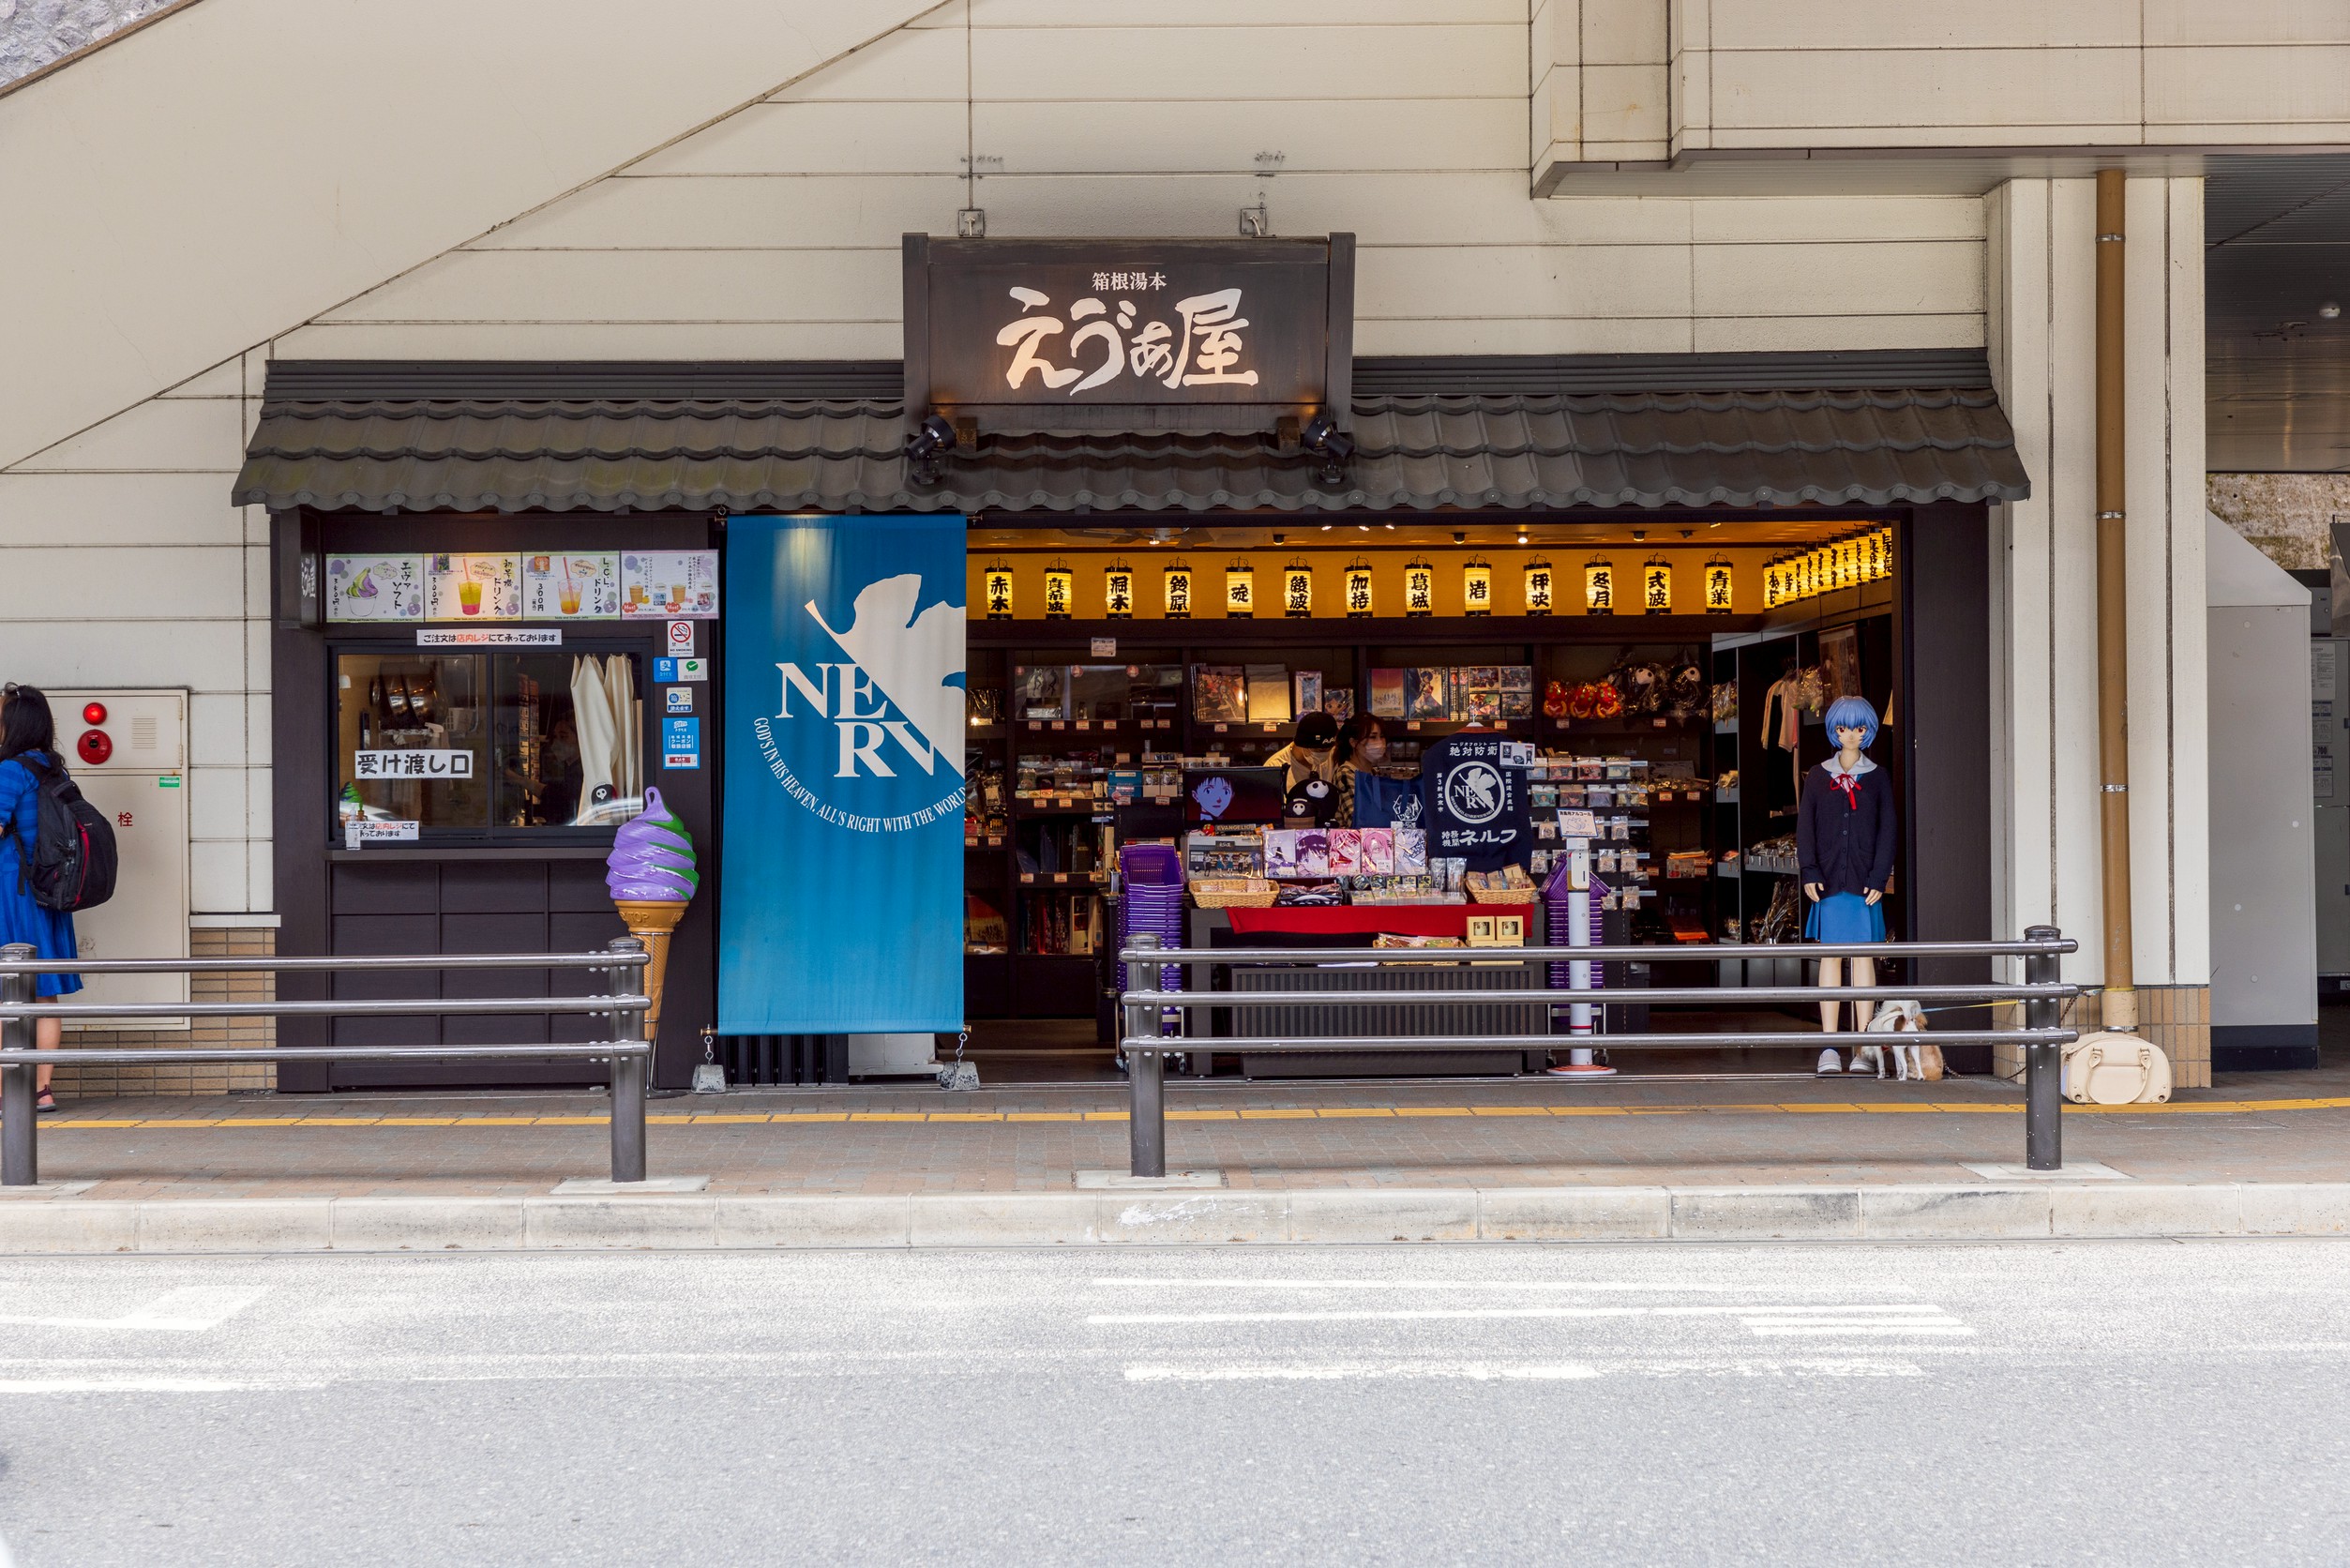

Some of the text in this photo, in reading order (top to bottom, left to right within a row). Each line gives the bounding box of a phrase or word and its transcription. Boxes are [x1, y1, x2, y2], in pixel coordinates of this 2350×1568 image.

[1092, 271, 1167, 291] 箱根湯本
[393, 581, 401, 610] ソフト
[493, 577, 502, 615] ドリンク
[594, 578, 602, 614] ドリンク
[989, 575, 1010, 612] 赤木
[1169, 574, 1189, 613] 鈴原
[1289, 575, 1309, 611] 綾波
[1350, 574, 1370, 611] 加持
[1410, 572, 1430, 610] 葛城
[1469, 580, 1487, 600] 渚
[1530, 572, 1550, 608] 伊吹
[1592, 571, 1611, 608] 冬月
[1648, 570, 1668, 608] 式波
[1710, 569, 1729, 606] 青葉
[423, 633, 557, 643] ご注文は店内レジにて承っております
[753, 716, 775, 749] GOD'S
[357, 753, 470, 776] 受け渡し口
[762, 746, 780, 762] IN
[1449, 746, 1498, 757] 絶対防衛
[770, 758, 790, 779] HIS
[816, 803, 847, 826] ALL'S
[846, 813, 881, 833] RIGHT
[882, 814, 912, 833] WITH
[912, 807, 936, 827] THE
[1459, 828, 1517, 846] ネルフ
